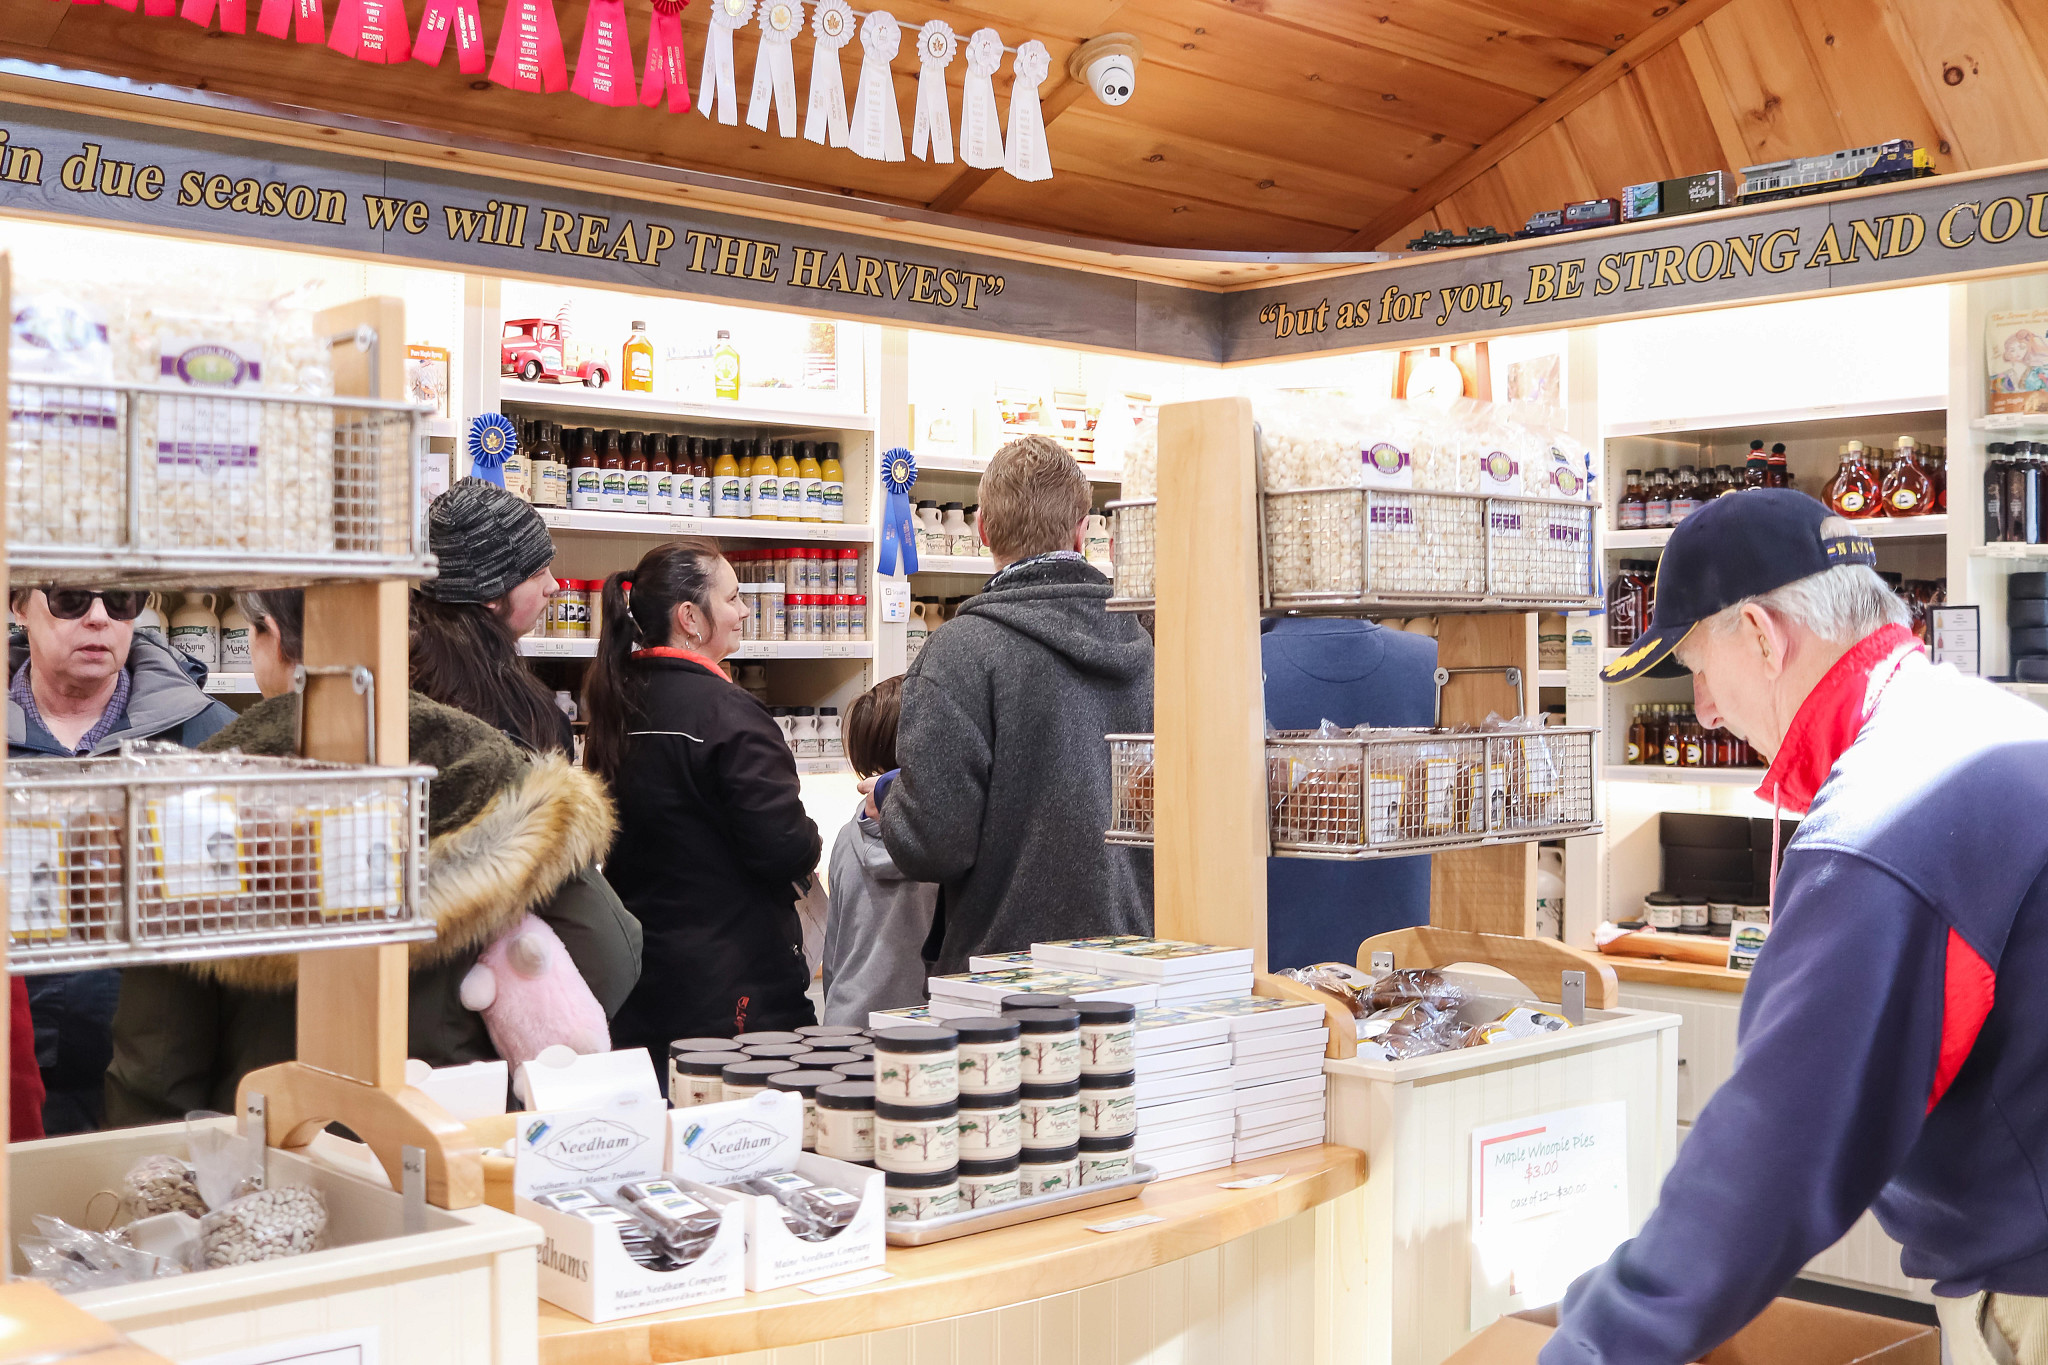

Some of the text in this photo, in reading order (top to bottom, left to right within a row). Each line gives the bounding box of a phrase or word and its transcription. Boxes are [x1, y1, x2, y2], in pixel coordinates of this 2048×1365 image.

[522, 13, 537, 22] MAPLE
[522, 24, 537, 32] MANIA
[598, 28, 612, 38] MAPLE
[362, 32, 384, 42] SECOND
[364, 40, 382, 50] PLACE
[518, 64, 538, 72] SECOND
[520, 72, 537, 80] PLACE
[592, 77, 612, 88] SECOND
[594, 84, 610, 92] PLACE
[60, 143, 165, 200] due
[178, 170, 346, 225] season
[363, 194, 430, 233] we
[443, 199, 529, 249] will
[536, 208, 675, 268] REAP
[686, 230, 780, 283] THE
[1336, 300, 1371, 330] as
[1378, 285, 1431, 326] for
[1436, 279, 1512, 326] you,
[1524, 258, 1586, 304] BE
[1594, 228, 1800, 296] STRONG
[1804, 212, 1926, 270] AND
[1936, 192, 2048, 250] COU
[556, 1137, 630, 1156] Needham
[707, 1136, 771, 1156] Needham
[1495, 1133, 1594, 1168] Maple Whoopie Pies
[570, 1152, 612, 1162] COMPANY
[754, 1167, 784, 1178] Tradition
[1524, 1160, 1558, 1184] $3.00
[529, 1181, 569, 1191] Needhams
[586, 1175, 608, 1183] Maine
[612, 1170, 646, 1180] Tradition
[1530, 1190, 1538, 1206] of
[774, 1259, 798, 1270] Maine
[837, 1243, 871, 1256] Company
[615, 1274, 728, 1300] Maine Needham Company
[614, 1286, 728, 1312] www.maineneedhams.com
